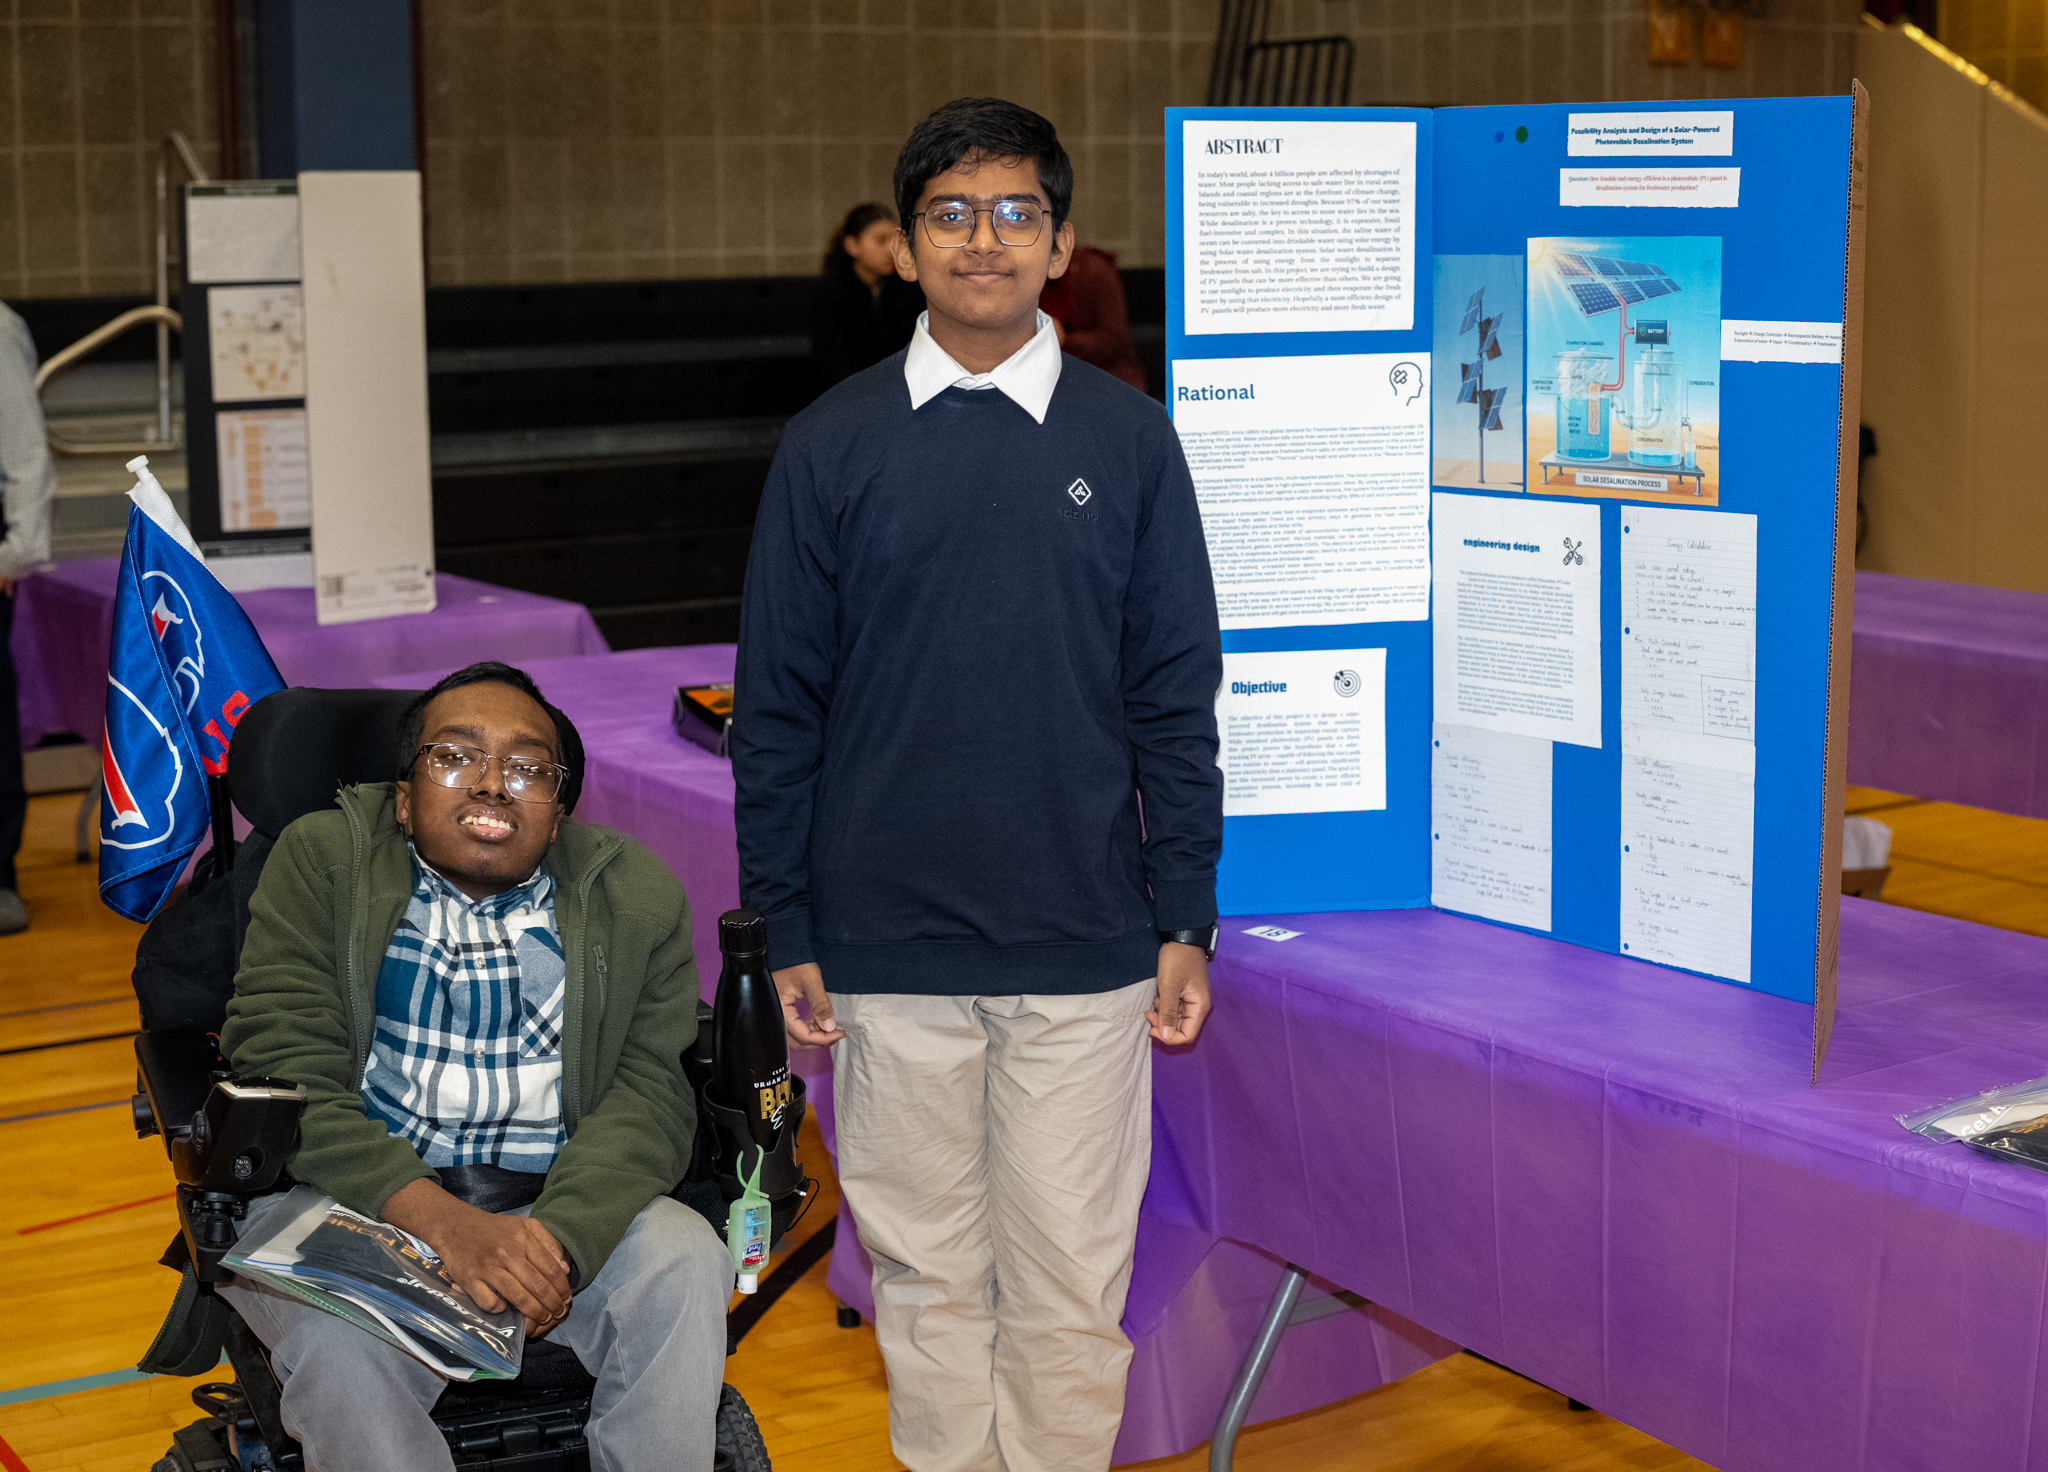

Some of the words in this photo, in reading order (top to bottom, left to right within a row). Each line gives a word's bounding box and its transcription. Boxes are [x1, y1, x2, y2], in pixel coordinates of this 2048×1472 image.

[1570, 127, 1601, 136] Feasibility
[1602, 127, 1628, 135] Analysis
[1640, 126, 1661, 134] Design
[1205, 139, 1283, 154] ABSTRACT
[1671, 137, 1693, 146] System
[1206, 170, 1228, 180] today's
[1295, 169, 1316, 178] people
[1363, 168, 1392, 177] shortages
[1235, 180, 1257, 189] people
[1257, 180, 1281, 188] lacking
[1259, 189, 1282, 198] regions
[1376, 187, 1400, 196] change,
[1198, 200, 1216, 209] being
[1290, 198, 1319, 207] droughts.
[1241, 209, 1257, 218] salty,
[1270, 209, 1281, 217] key
[1178, 384, 1255, 401] Rational
[1582, 475, 1599, 483] SOLAR
[1599, 476, 1637, 486] DESALINATION
[1637, 479, 1661, 488] PROCESS
[1464, 538, 1511, 551] engineering
[1513, 541, 1540, 552] design
[1232, 681, 1286, 696] Objective
[754, 1076, 781, 1088] URBAN
